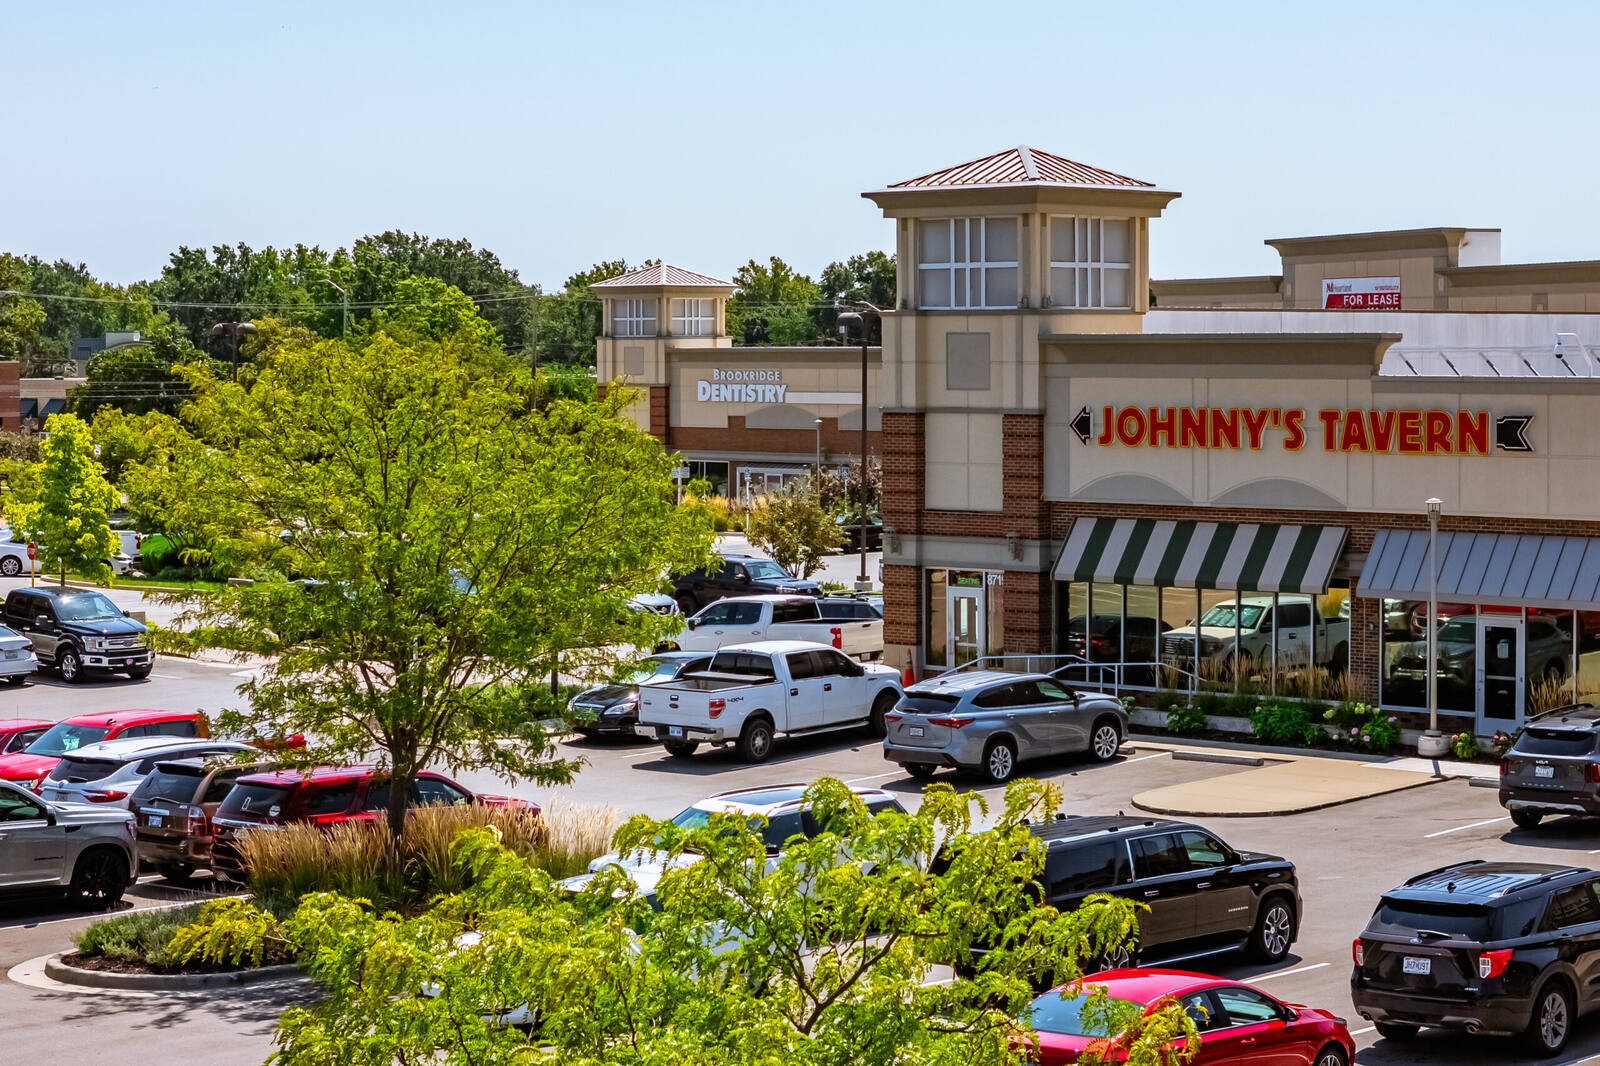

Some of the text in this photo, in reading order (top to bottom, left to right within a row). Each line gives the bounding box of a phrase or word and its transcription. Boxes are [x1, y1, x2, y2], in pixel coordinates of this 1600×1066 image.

[1343, 294, 1399, 305] FOR LEASE
[713, 368, 780, 381] BROOKRIDGE
[697, 380, 787, 403] DENTISTRY
[1098, 405, 1491, 456] JOHNNY'S TAVERN
